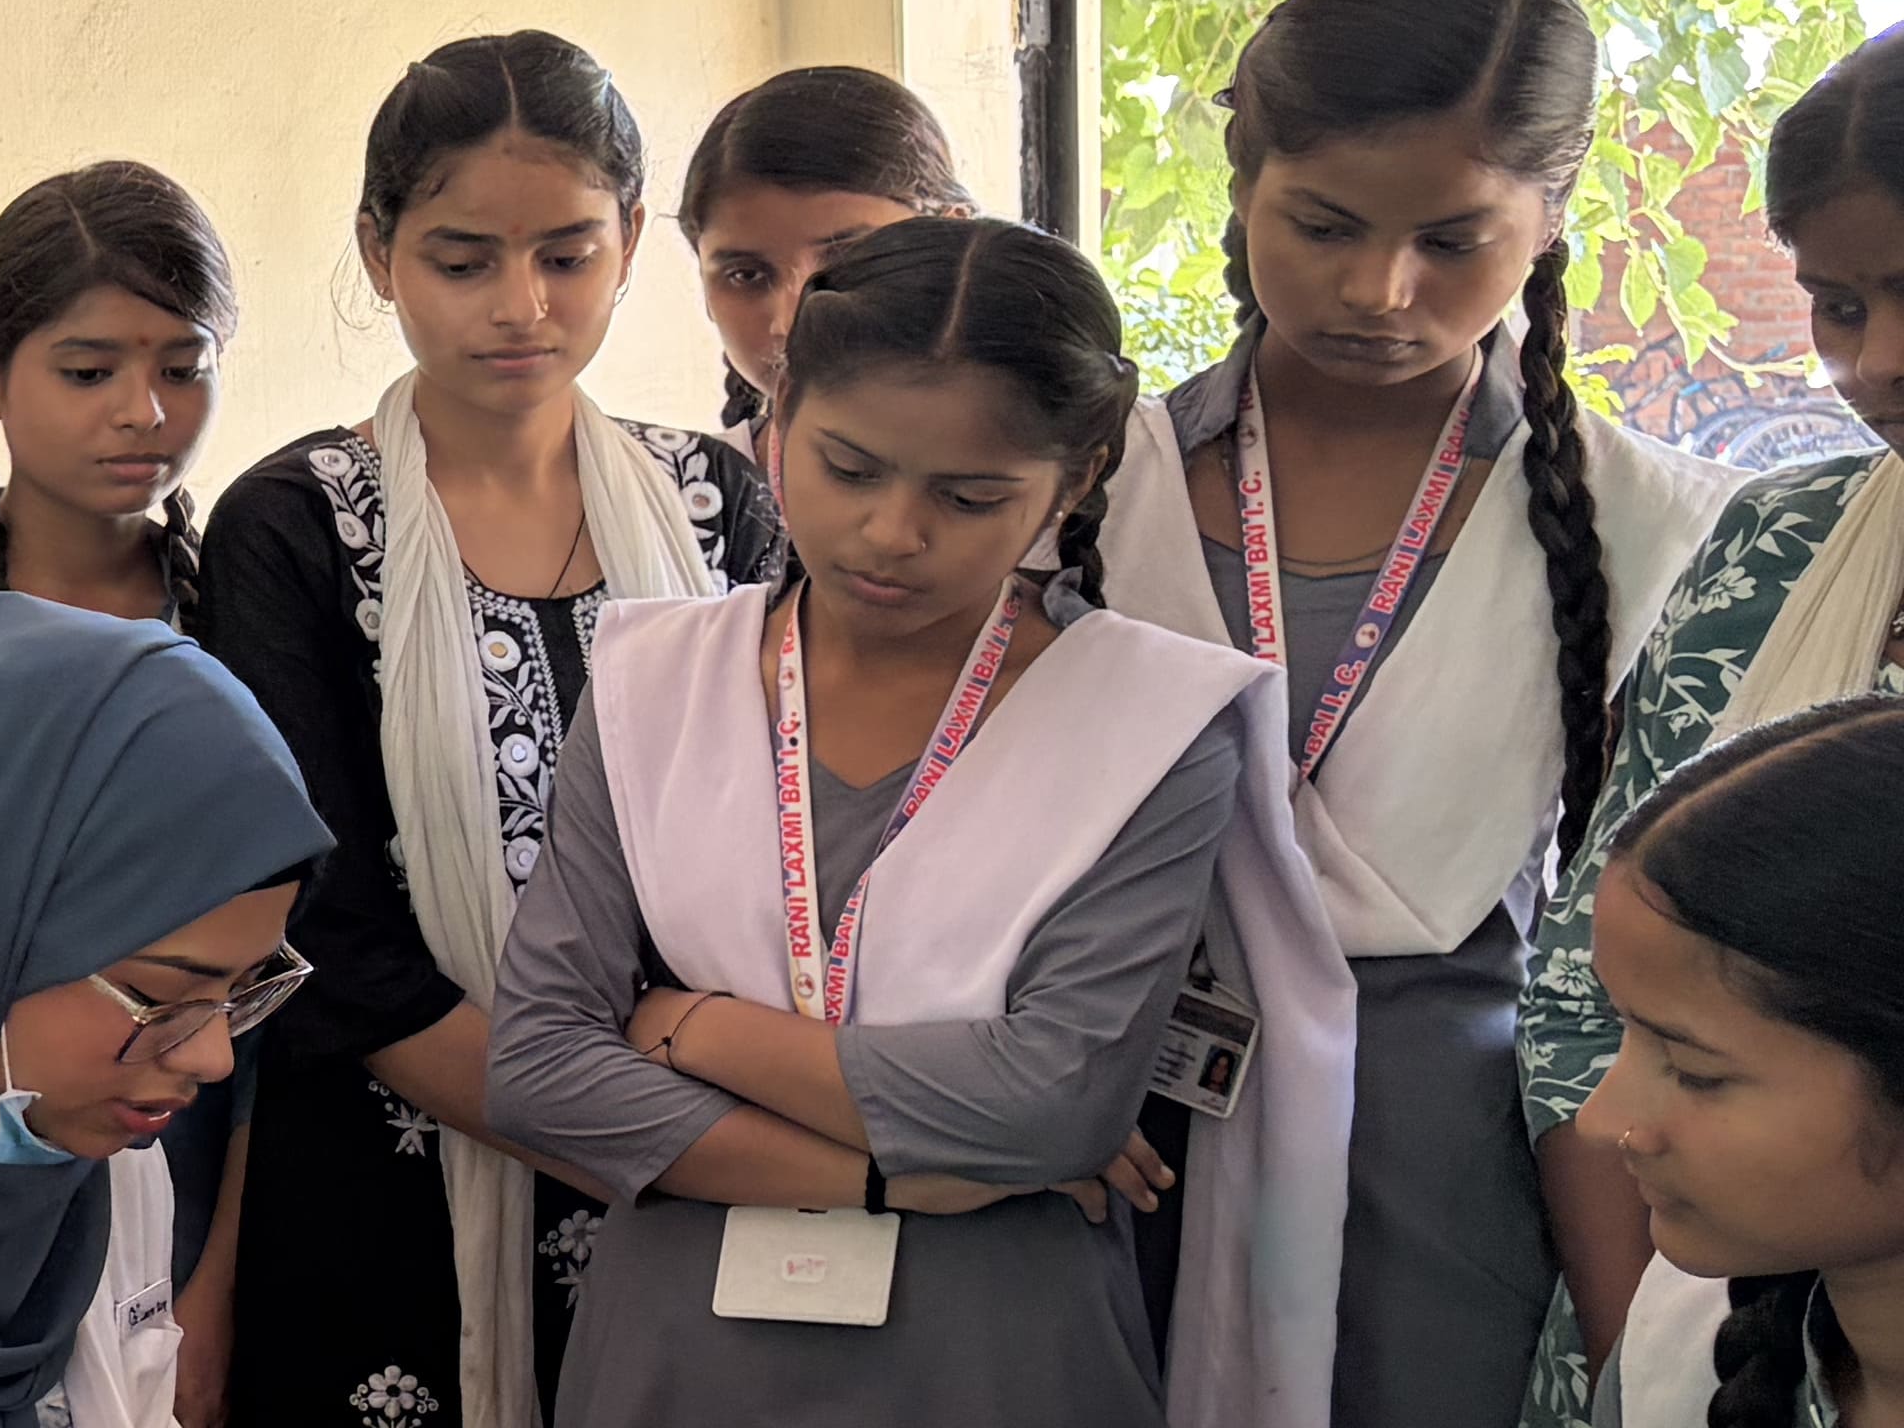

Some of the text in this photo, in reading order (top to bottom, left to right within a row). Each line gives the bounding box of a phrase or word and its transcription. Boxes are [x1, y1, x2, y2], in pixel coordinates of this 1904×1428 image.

[1244, 519, 1270, 563] BAI
[1369, 552, 1418, 613] RANI
[1402, 470, 1453, 549] LAXMI
[1249, 571, 1278, 647] LAXMI
[777, 710, 801, 737] C.
[903, 757, 948, 819] RANI
[935, 680, 987, 760] LAXMI
[973, 642, 1005, 682] BAI
[1303, 712, 1337, 759] BAI
[779, 757, 802, 804] BAI
[784, 812, 808, 893] LAXMI
[790, 894, 812, 959] RANI
[831, 915, 855, 958] BAI
